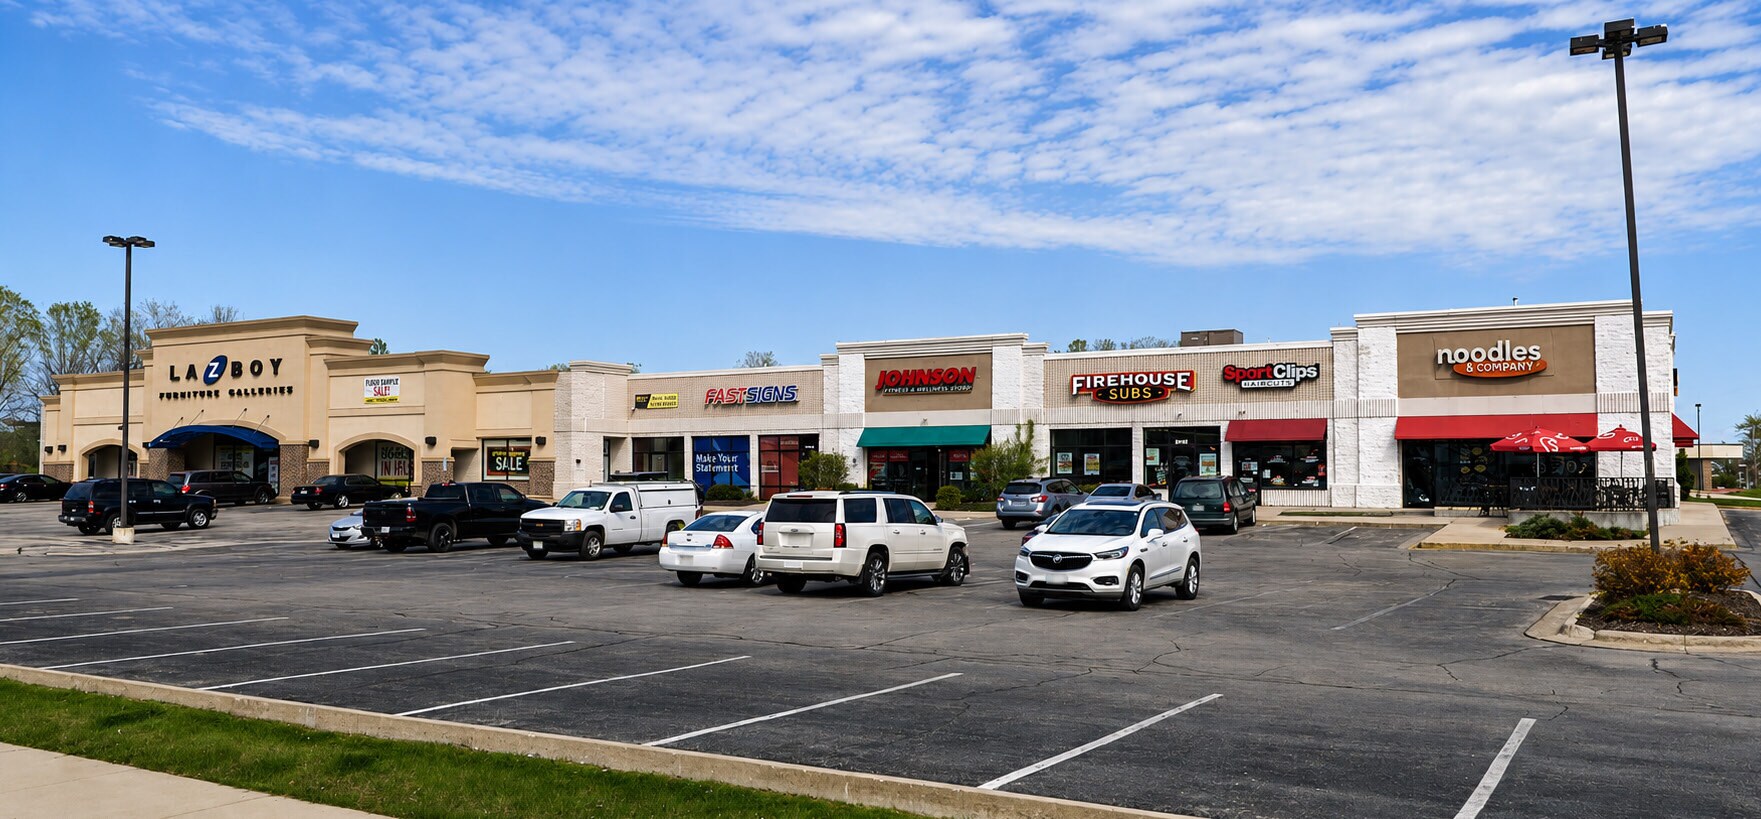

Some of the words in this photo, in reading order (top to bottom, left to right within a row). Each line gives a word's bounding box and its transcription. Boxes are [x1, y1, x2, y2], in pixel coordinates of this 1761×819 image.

[1437, 340, 1541, 364] noodles
[1466, 362, 1473, 373] &
[1477, 361, 1534, 372] COMPANY
[875, 366, 977, 391] JOHNSON
[1072, 372, 1191, 395] FIREHOUSE
[159, 389, 220, 400] FURNITURE
[228, 386, 294, 397] GALLERIES
[704, 385, 799, 405] FASTSIGNS
[1109, 387, 1152, 400] SUBS
[495, 456, 523, 471] SALE
[695, 454, 716, 463] Make
[718, 453, 738, 463] Your
[695, 464, 739, 472] Statement
